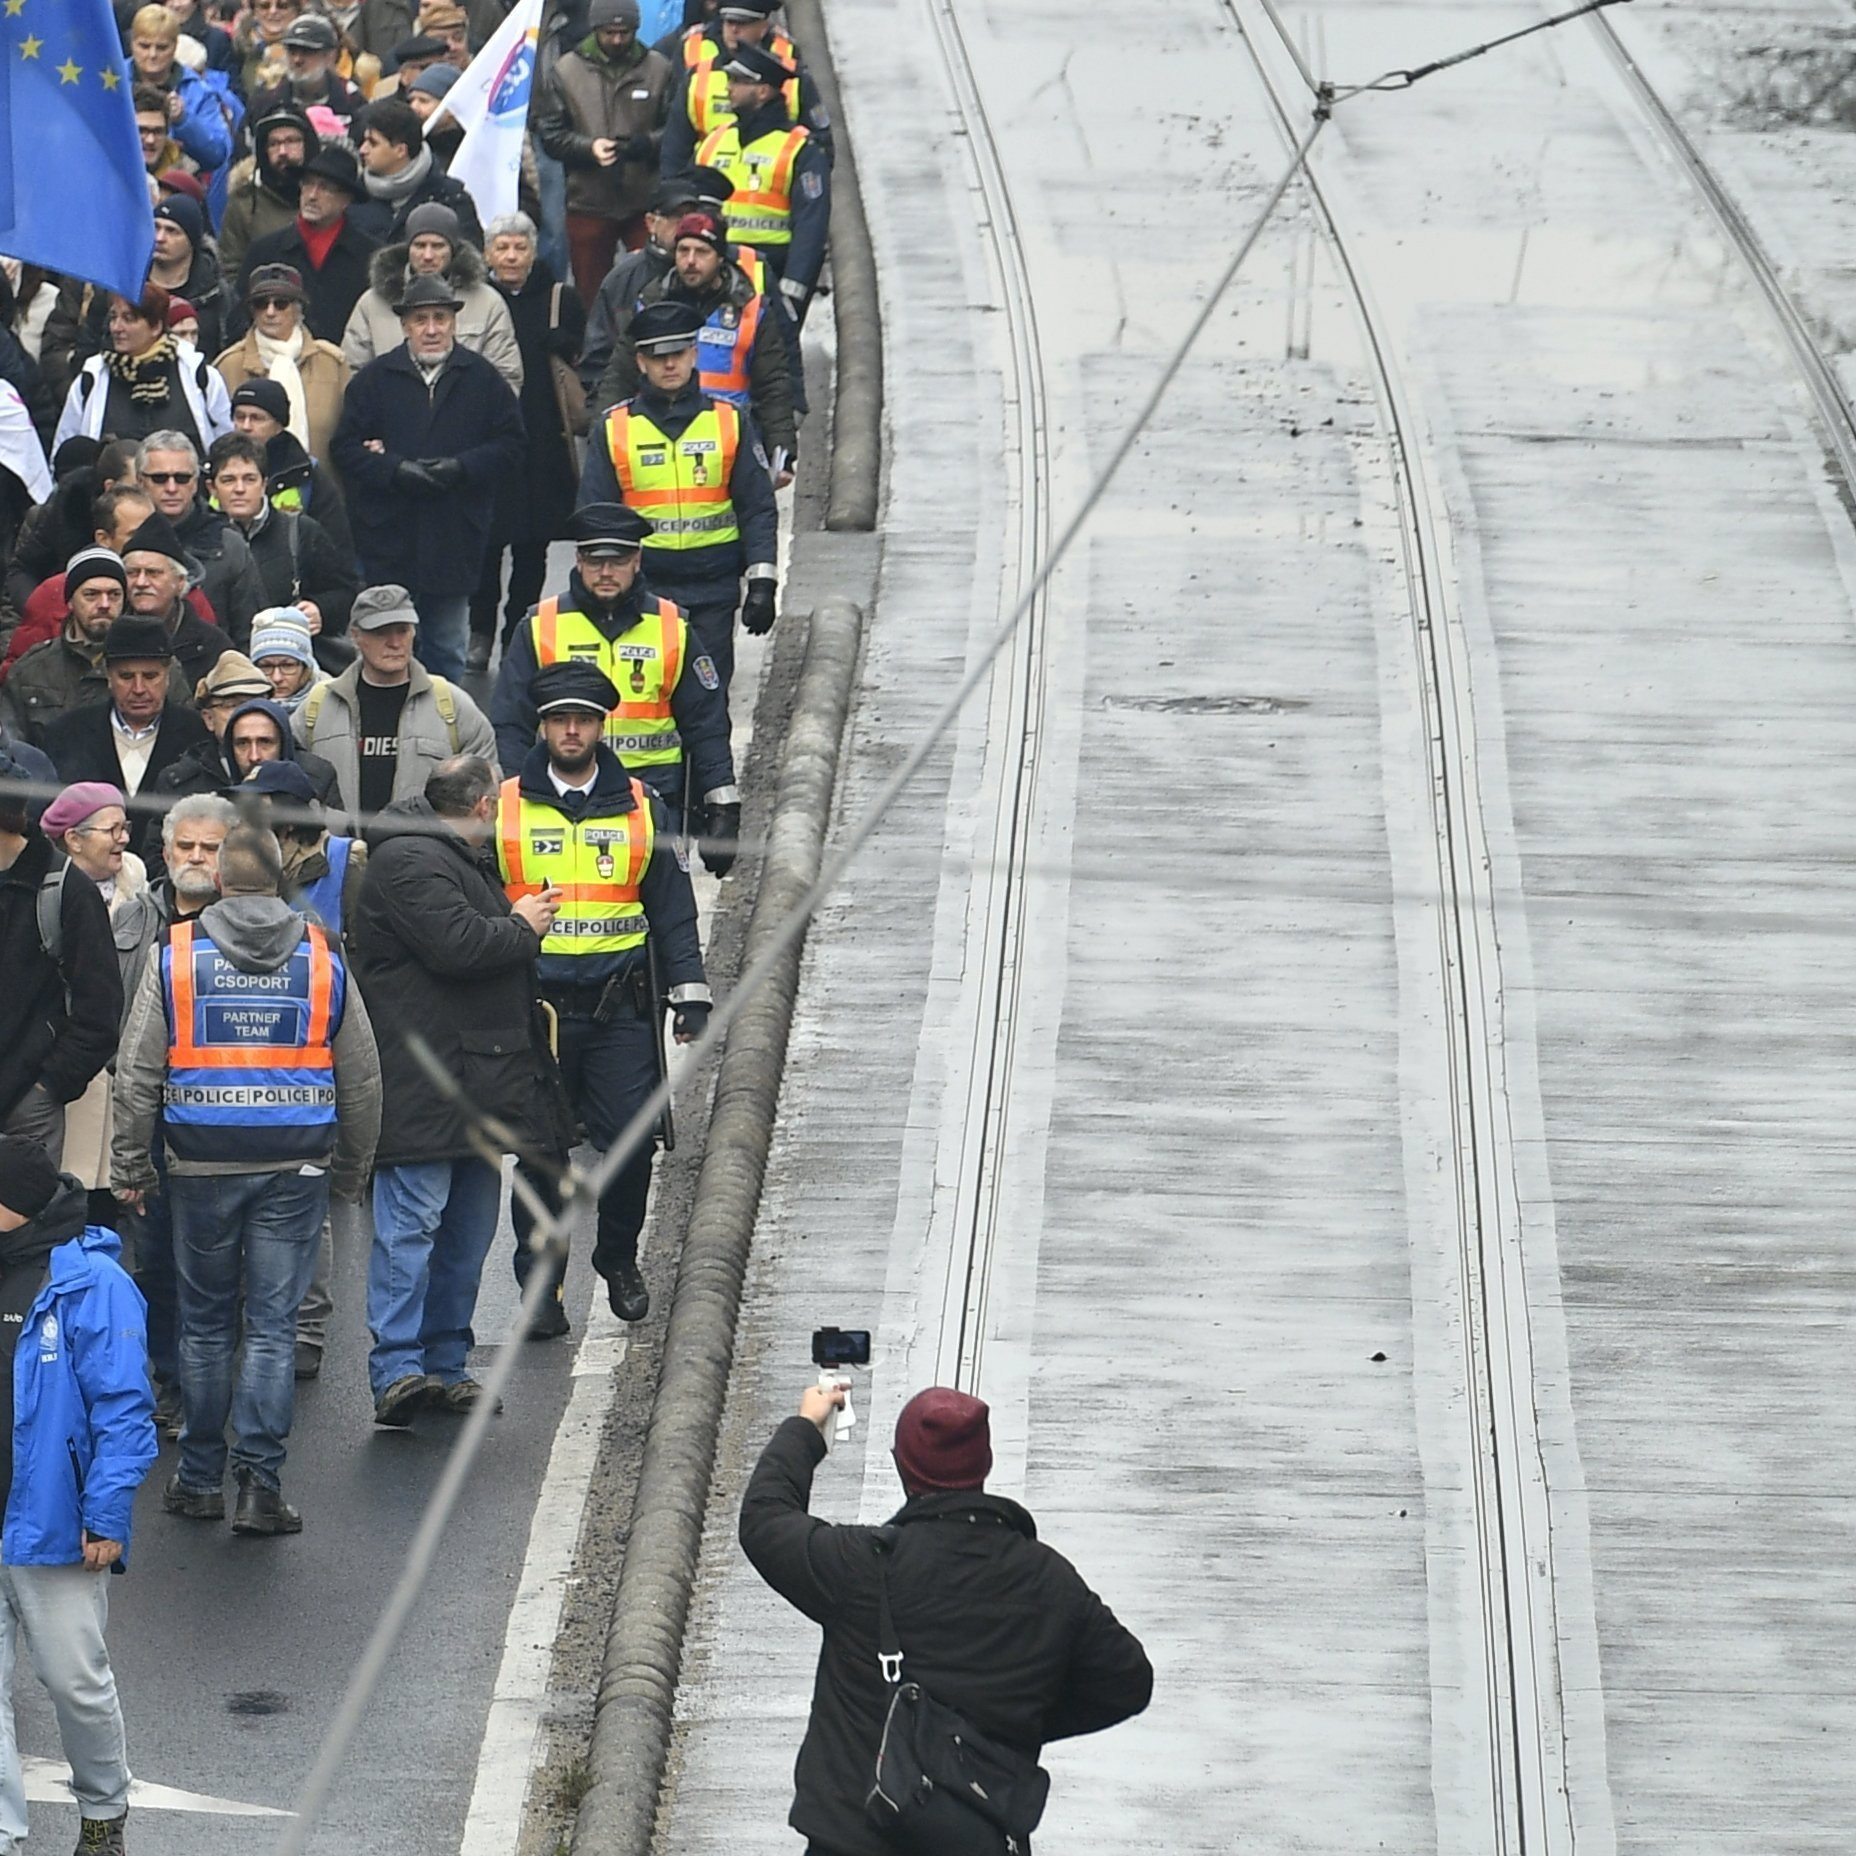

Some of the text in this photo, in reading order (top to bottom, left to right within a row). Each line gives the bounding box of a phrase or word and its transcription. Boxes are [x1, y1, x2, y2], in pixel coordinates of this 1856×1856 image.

[619, 645, 656, 658] POLICE
[363, 736, 398, 756] DIES
[585, 830, 625, 842] POLICE
[579, 919, 630, 935] POLICE
[214, 975, 292, 990] CSOPORT
[223, 1011, 281, 1024] PARTNER
[235, 1026, 270, 1037] TEAM
[184, 1090, 245, 1104] POLICE
[253, 1089, 310, 1103] POLICE
